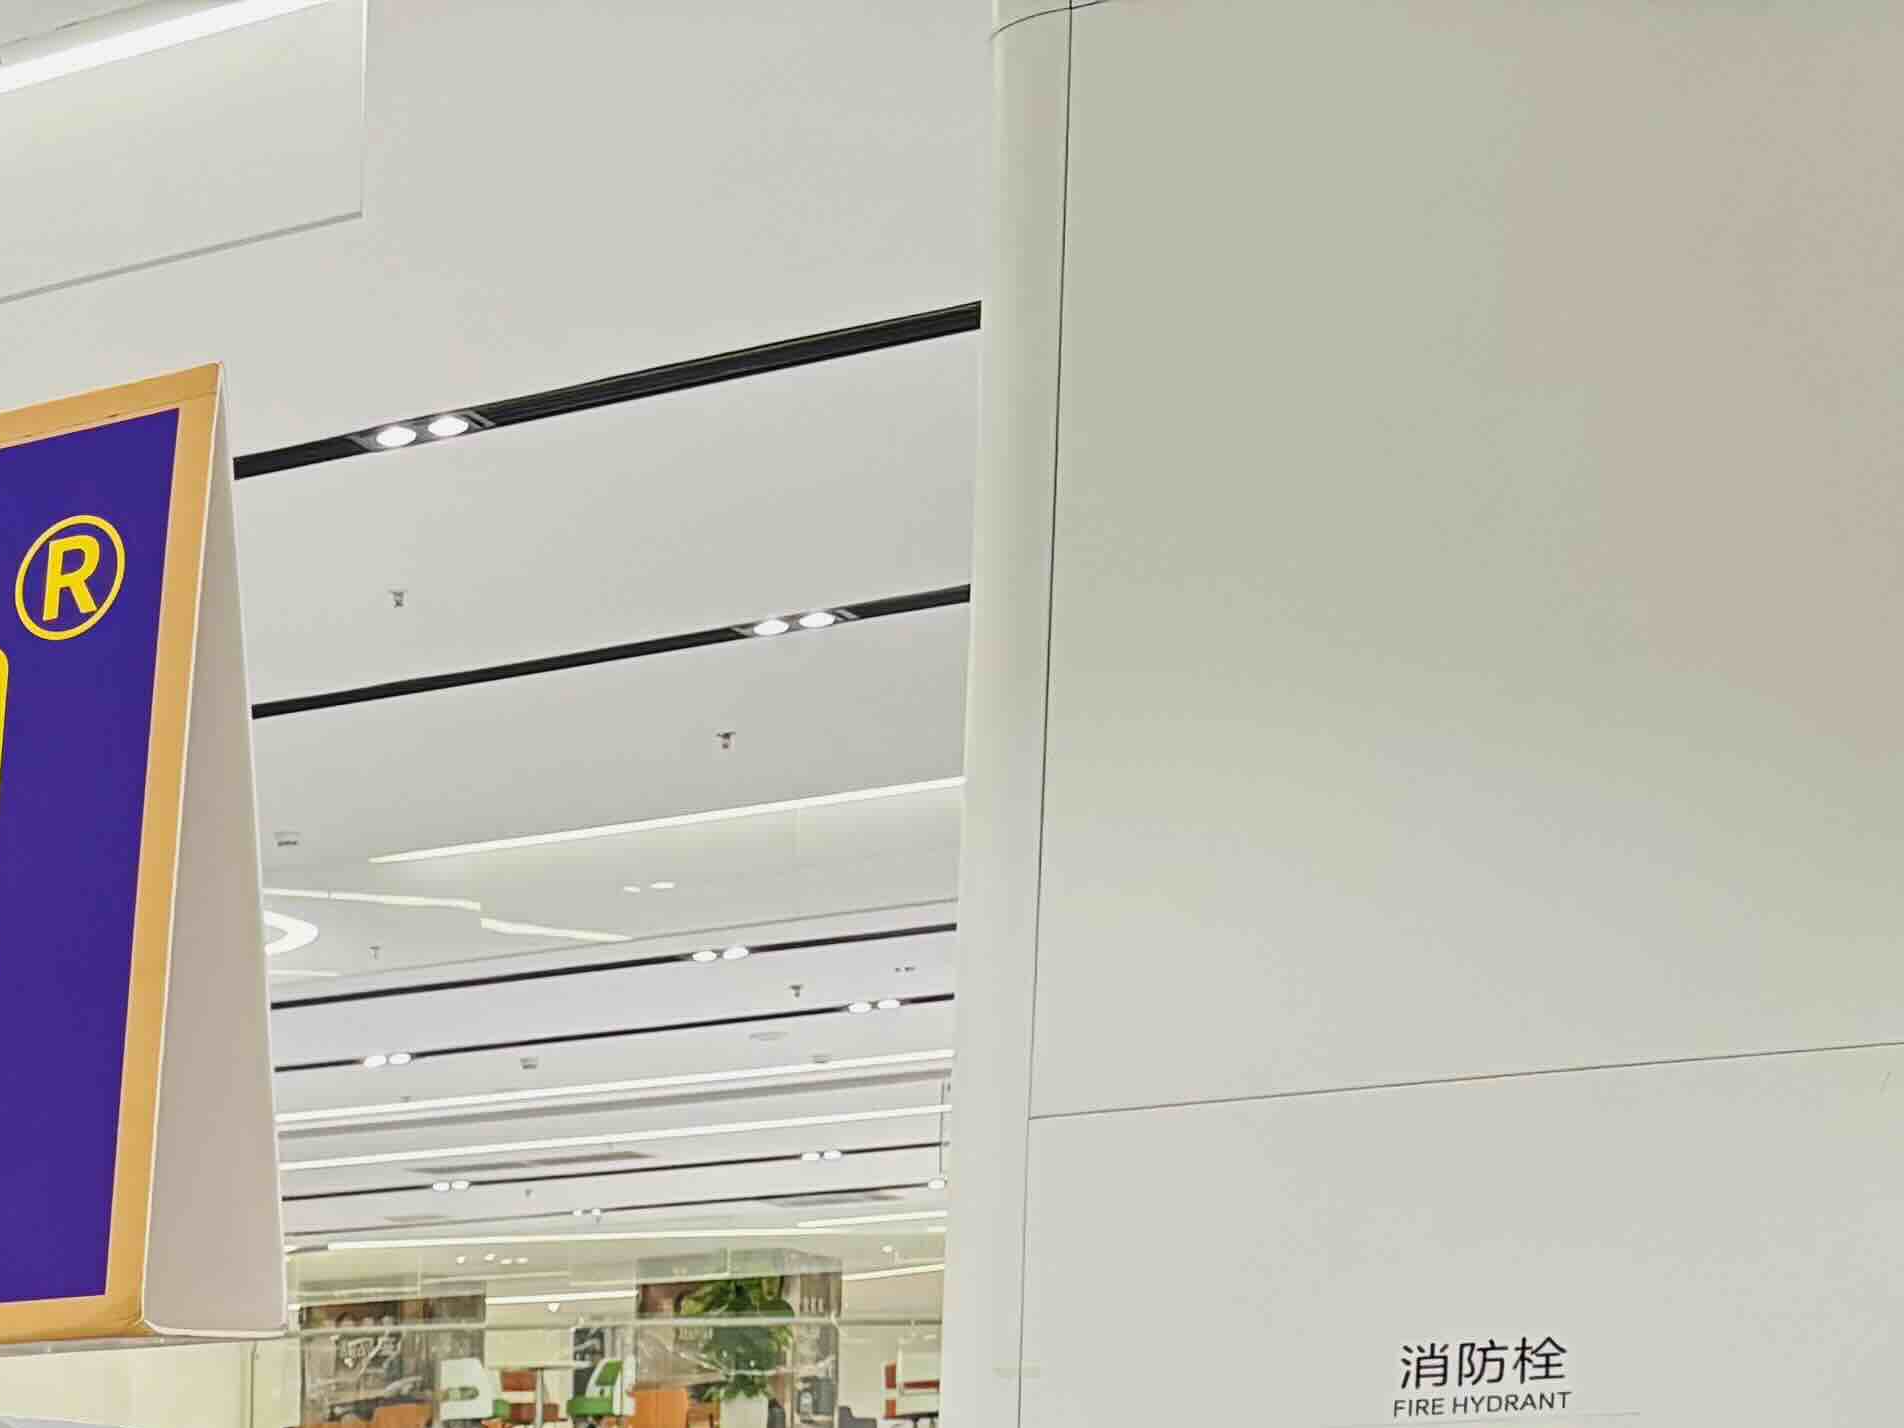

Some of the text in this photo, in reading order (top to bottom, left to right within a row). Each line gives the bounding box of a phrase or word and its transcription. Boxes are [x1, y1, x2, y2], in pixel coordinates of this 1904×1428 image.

[1400, 1336, 1568, 1390] 消防栓
[1393, 1391, 1573, 1418] FIRE HYDRANT
